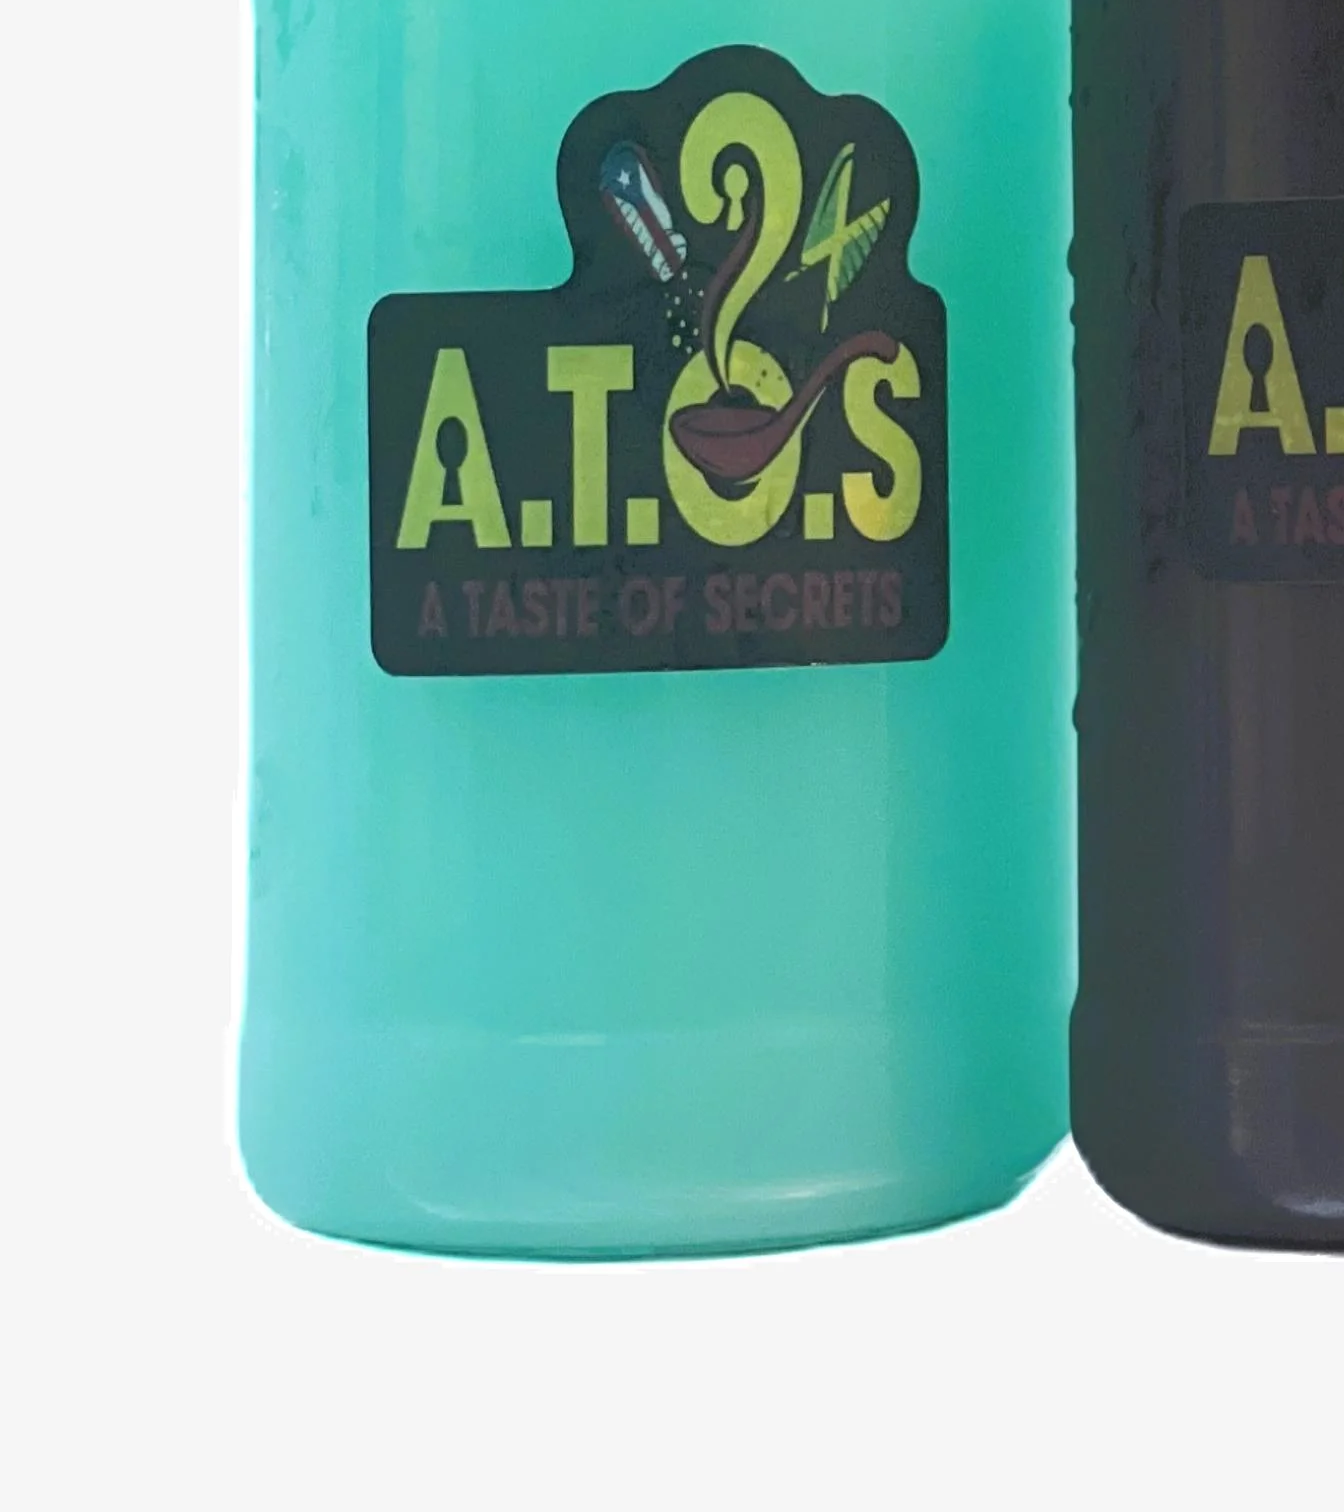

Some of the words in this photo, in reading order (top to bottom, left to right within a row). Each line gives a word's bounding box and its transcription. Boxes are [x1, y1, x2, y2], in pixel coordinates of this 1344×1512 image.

[396, 340, 922, 550] A.T.O.S
[1230, 490, 1256, 545] A
[418, 582, 448, 636] A
[463, 576, 599, 636] TASTE
[618, 576, 687, 634] OF
[705, 571, 901, 633] SECRETS
